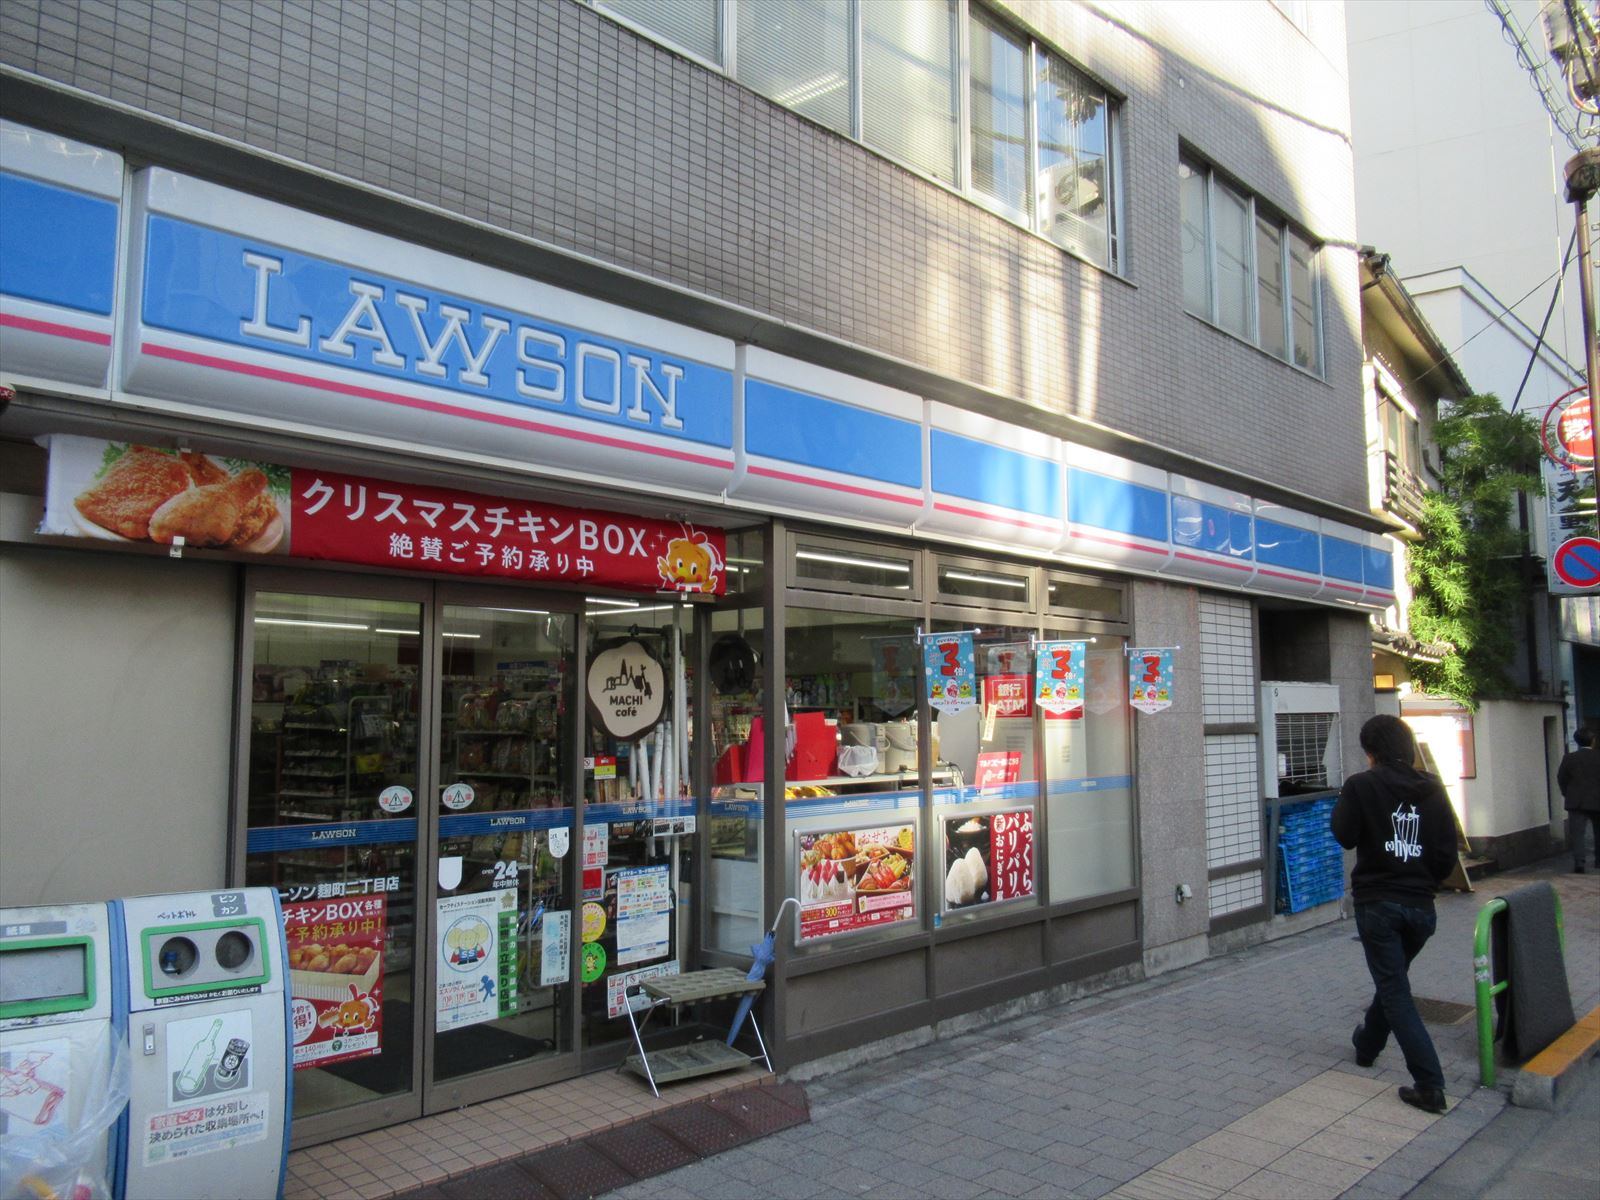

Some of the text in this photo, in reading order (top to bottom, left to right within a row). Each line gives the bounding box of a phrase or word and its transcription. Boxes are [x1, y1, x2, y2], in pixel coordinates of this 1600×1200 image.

[240, 252, 685, 431] LAWSON
[301, 477, 649, 558] クリスマスチキンBOX
[388, 532, 595, 576] 絶賛ご予約承り中
[997, 683, 1021, 697] 銀行
[609, 695, 644, 706] MACHI
[996, 699, 1025, 711] ATM
[615, 706, 638, 717] café
[490, 816, 526, 826] LAWSON
[311, 828, 357, 841] LAWSON
[493, 860, 519, 881] 24
[317, 876, 400, 899] 麹町二丁目店
[221, 906, 239, 914] カン
